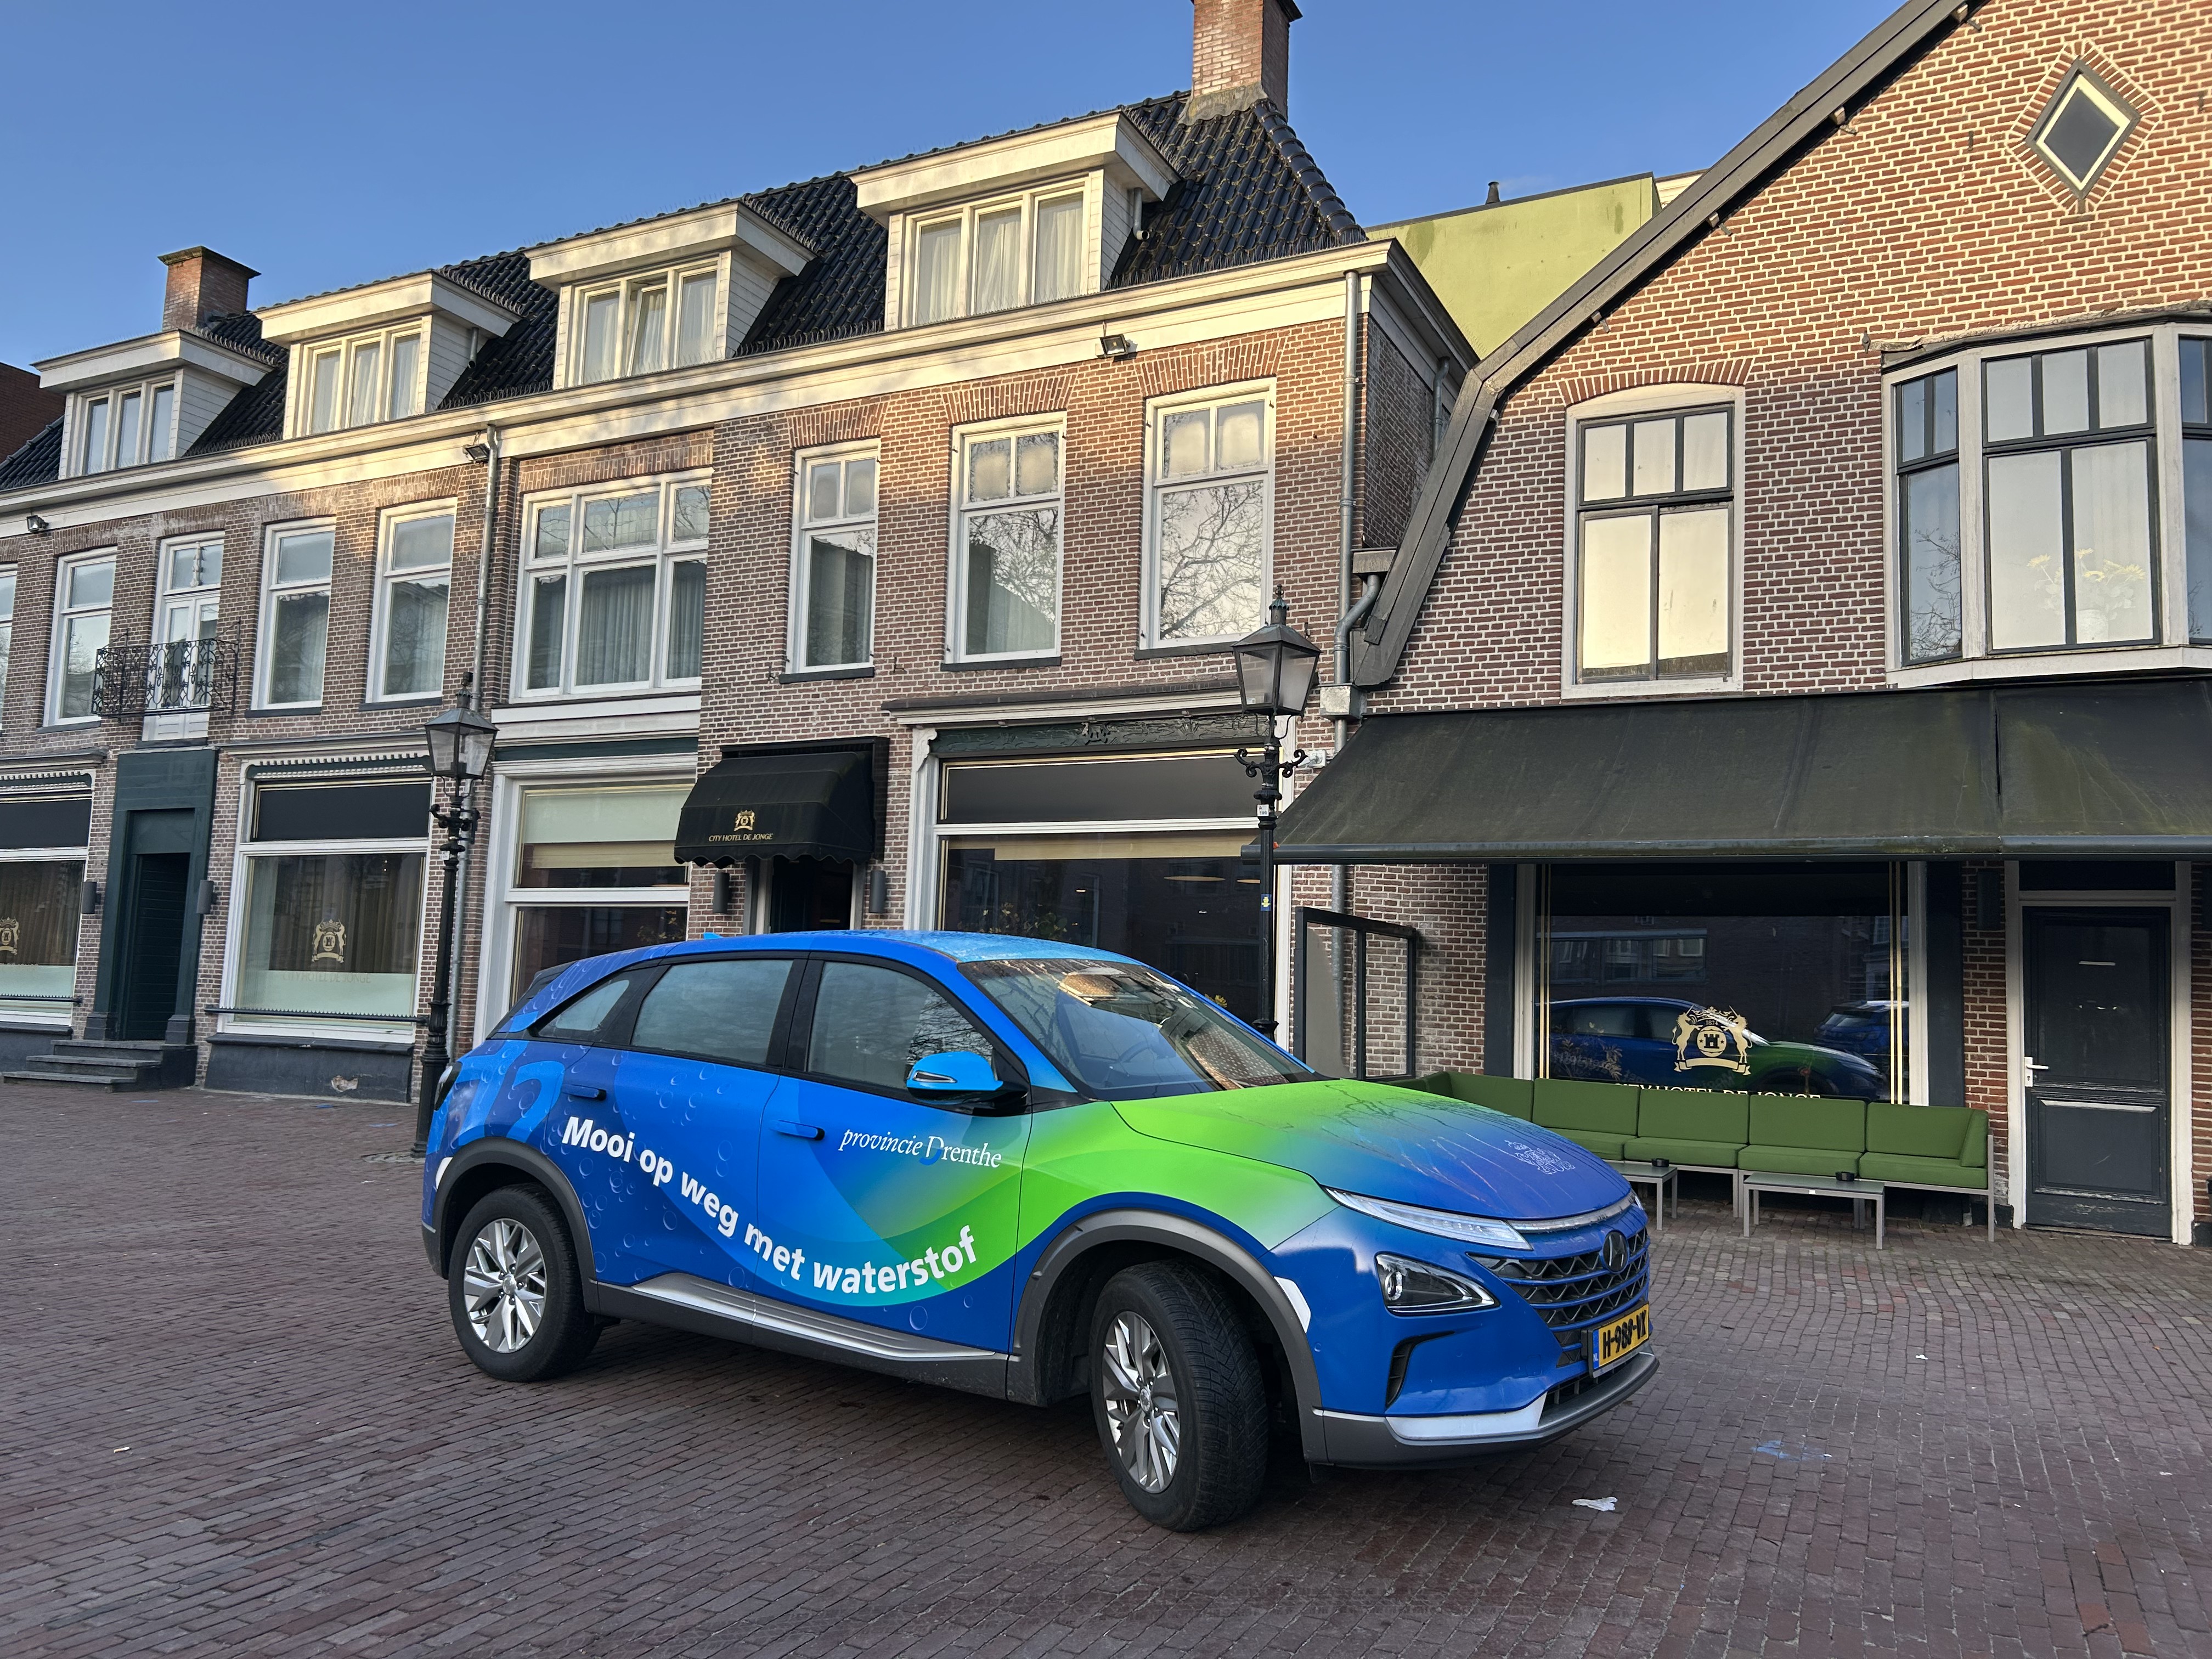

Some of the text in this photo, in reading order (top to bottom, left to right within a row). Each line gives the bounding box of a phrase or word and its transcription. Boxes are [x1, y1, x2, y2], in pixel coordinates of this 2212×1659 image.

[301, 972, 329, 982] HOTEL
[342, 973, 371, 984] JONGE
[838, 1128, 1002, 1169] provincie Drenthe
[561, 1116, 977, 1294] Mooi op weg met waterstof
[1593, 1352, 1599, 1362] NL
